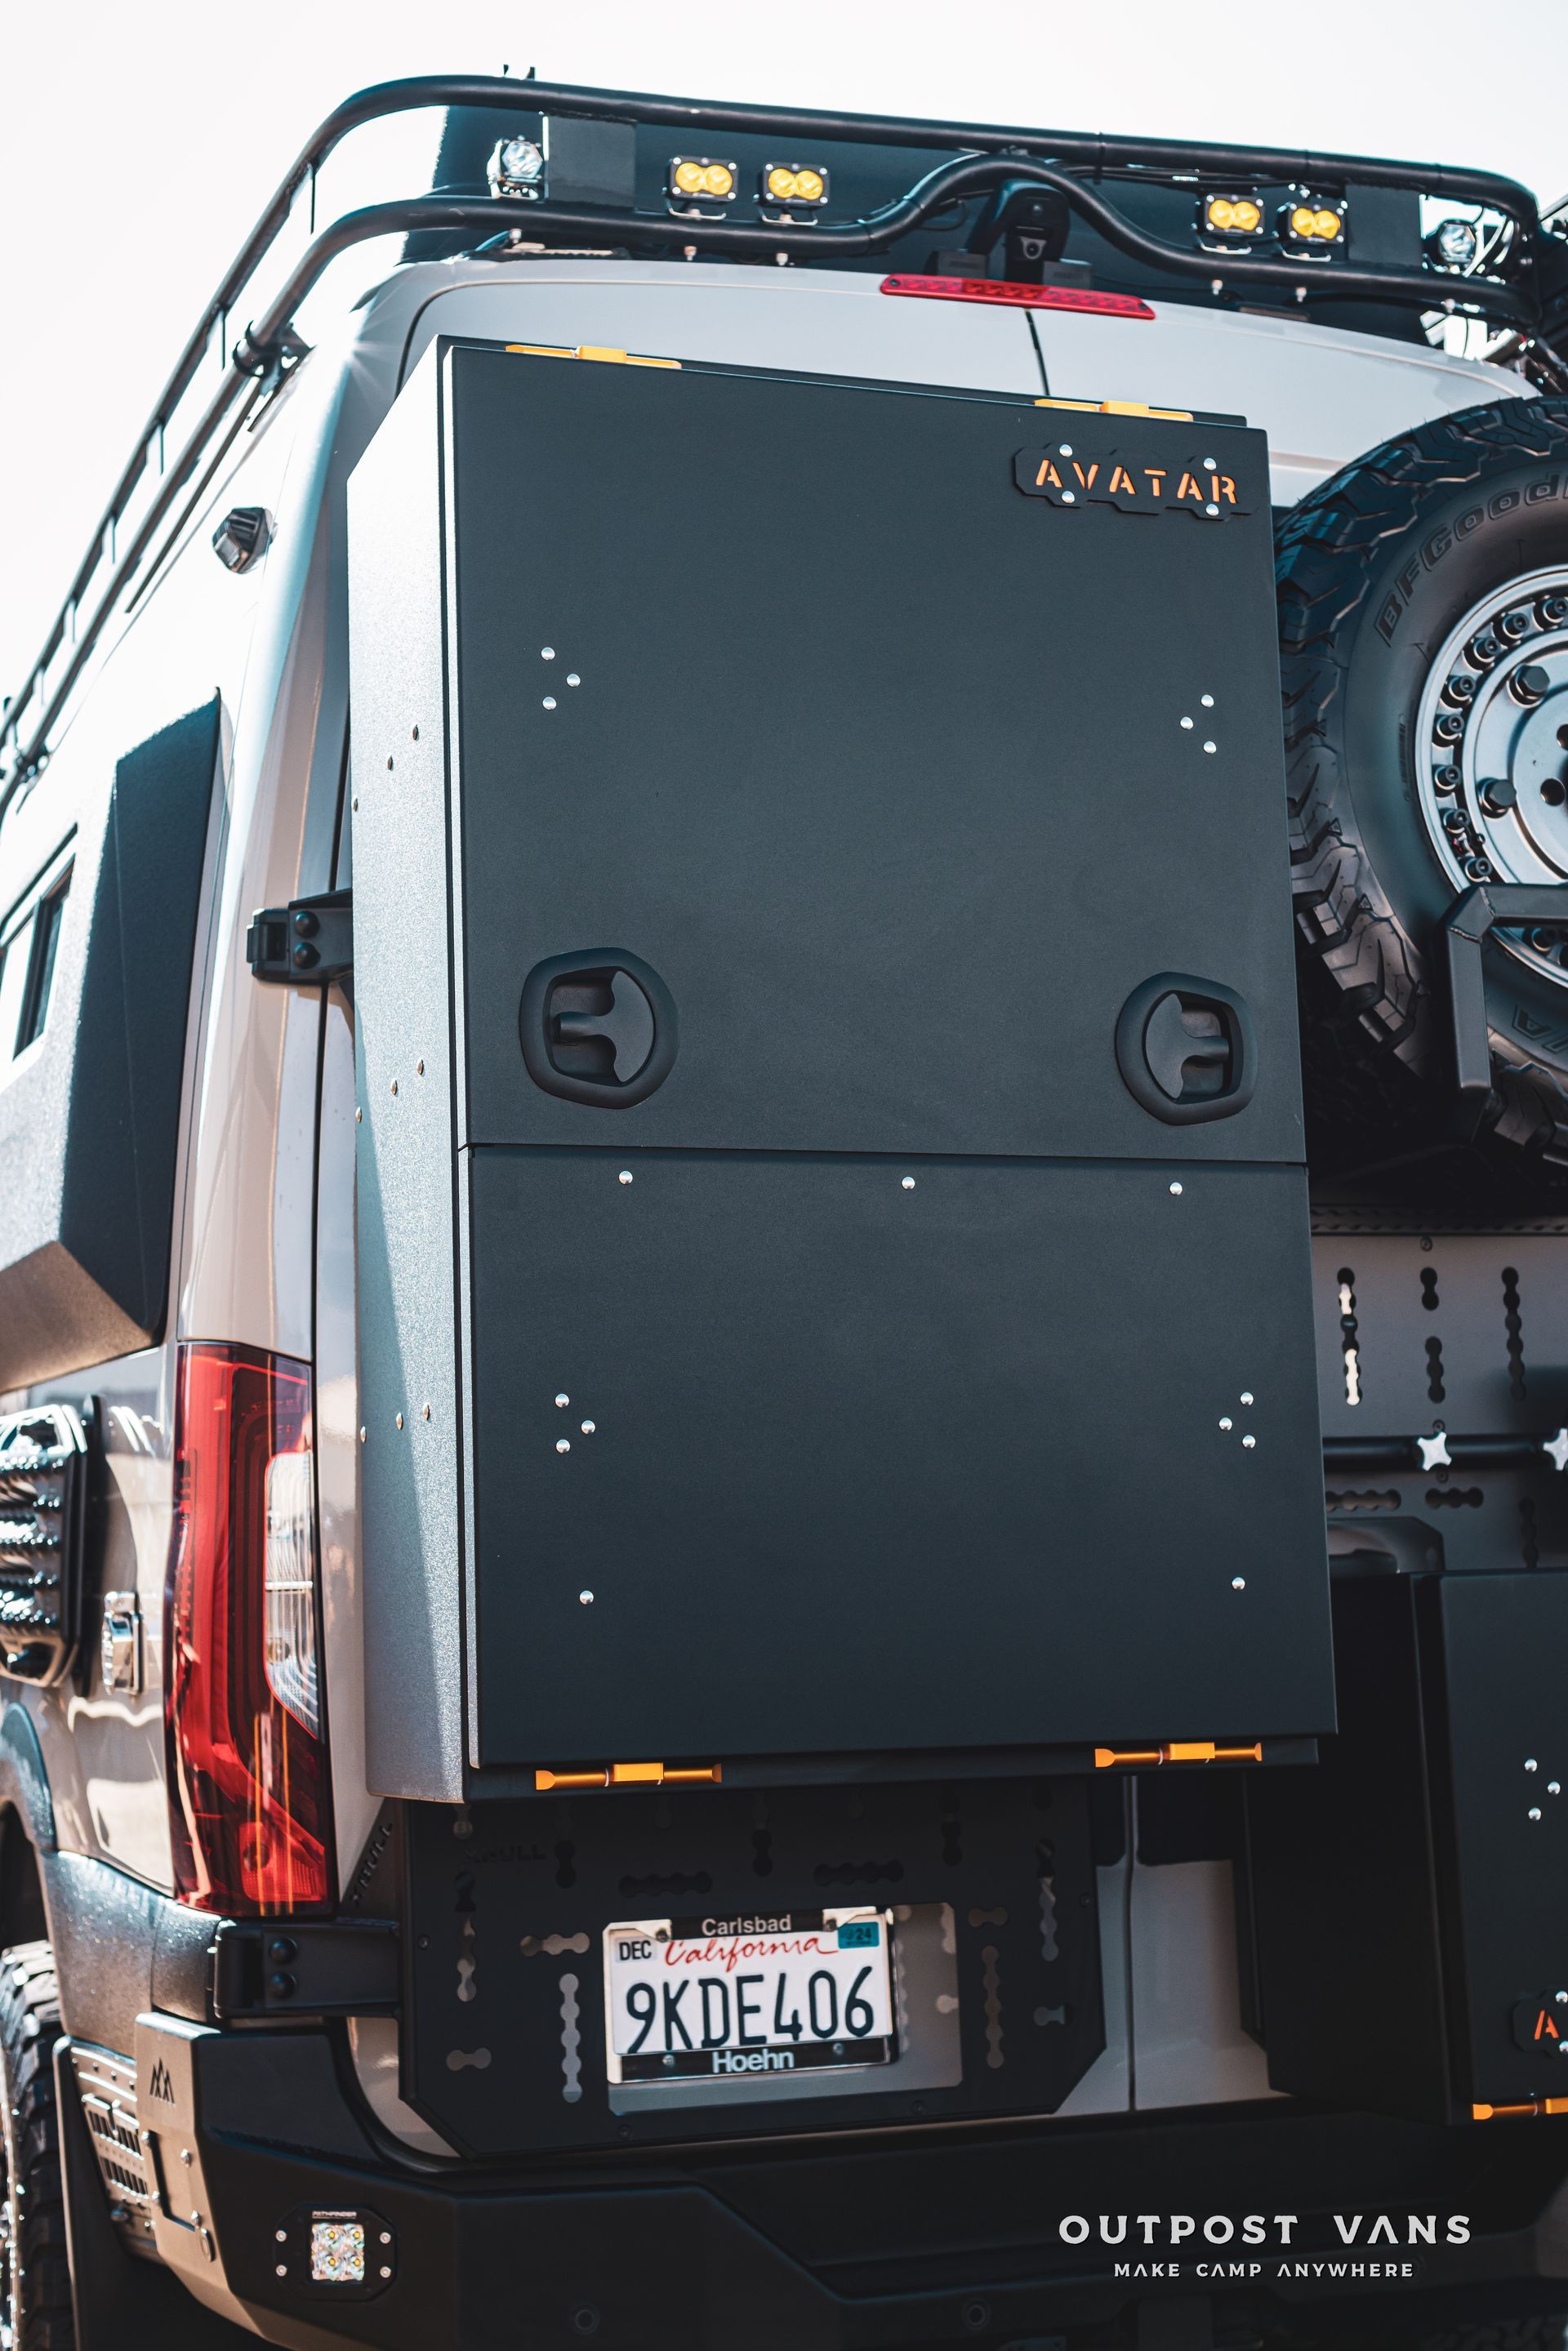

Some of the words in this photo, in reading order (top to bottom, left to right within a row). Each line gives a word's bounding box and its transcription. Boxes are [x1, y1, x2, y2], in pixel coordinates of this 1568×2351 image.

[1035, 458, 1238, 504] AVATAR
[1374, 471, 1568, 648] BFGood
[702, 1915, 791, 1936] Carlsbad
[618, 1940, 652, 1960] DEC
[663, 1936, 839, 1973] California
[626, 1966, 874, 2054] 9KDE406
[712, 2049, 795, 2073] Hoehn
